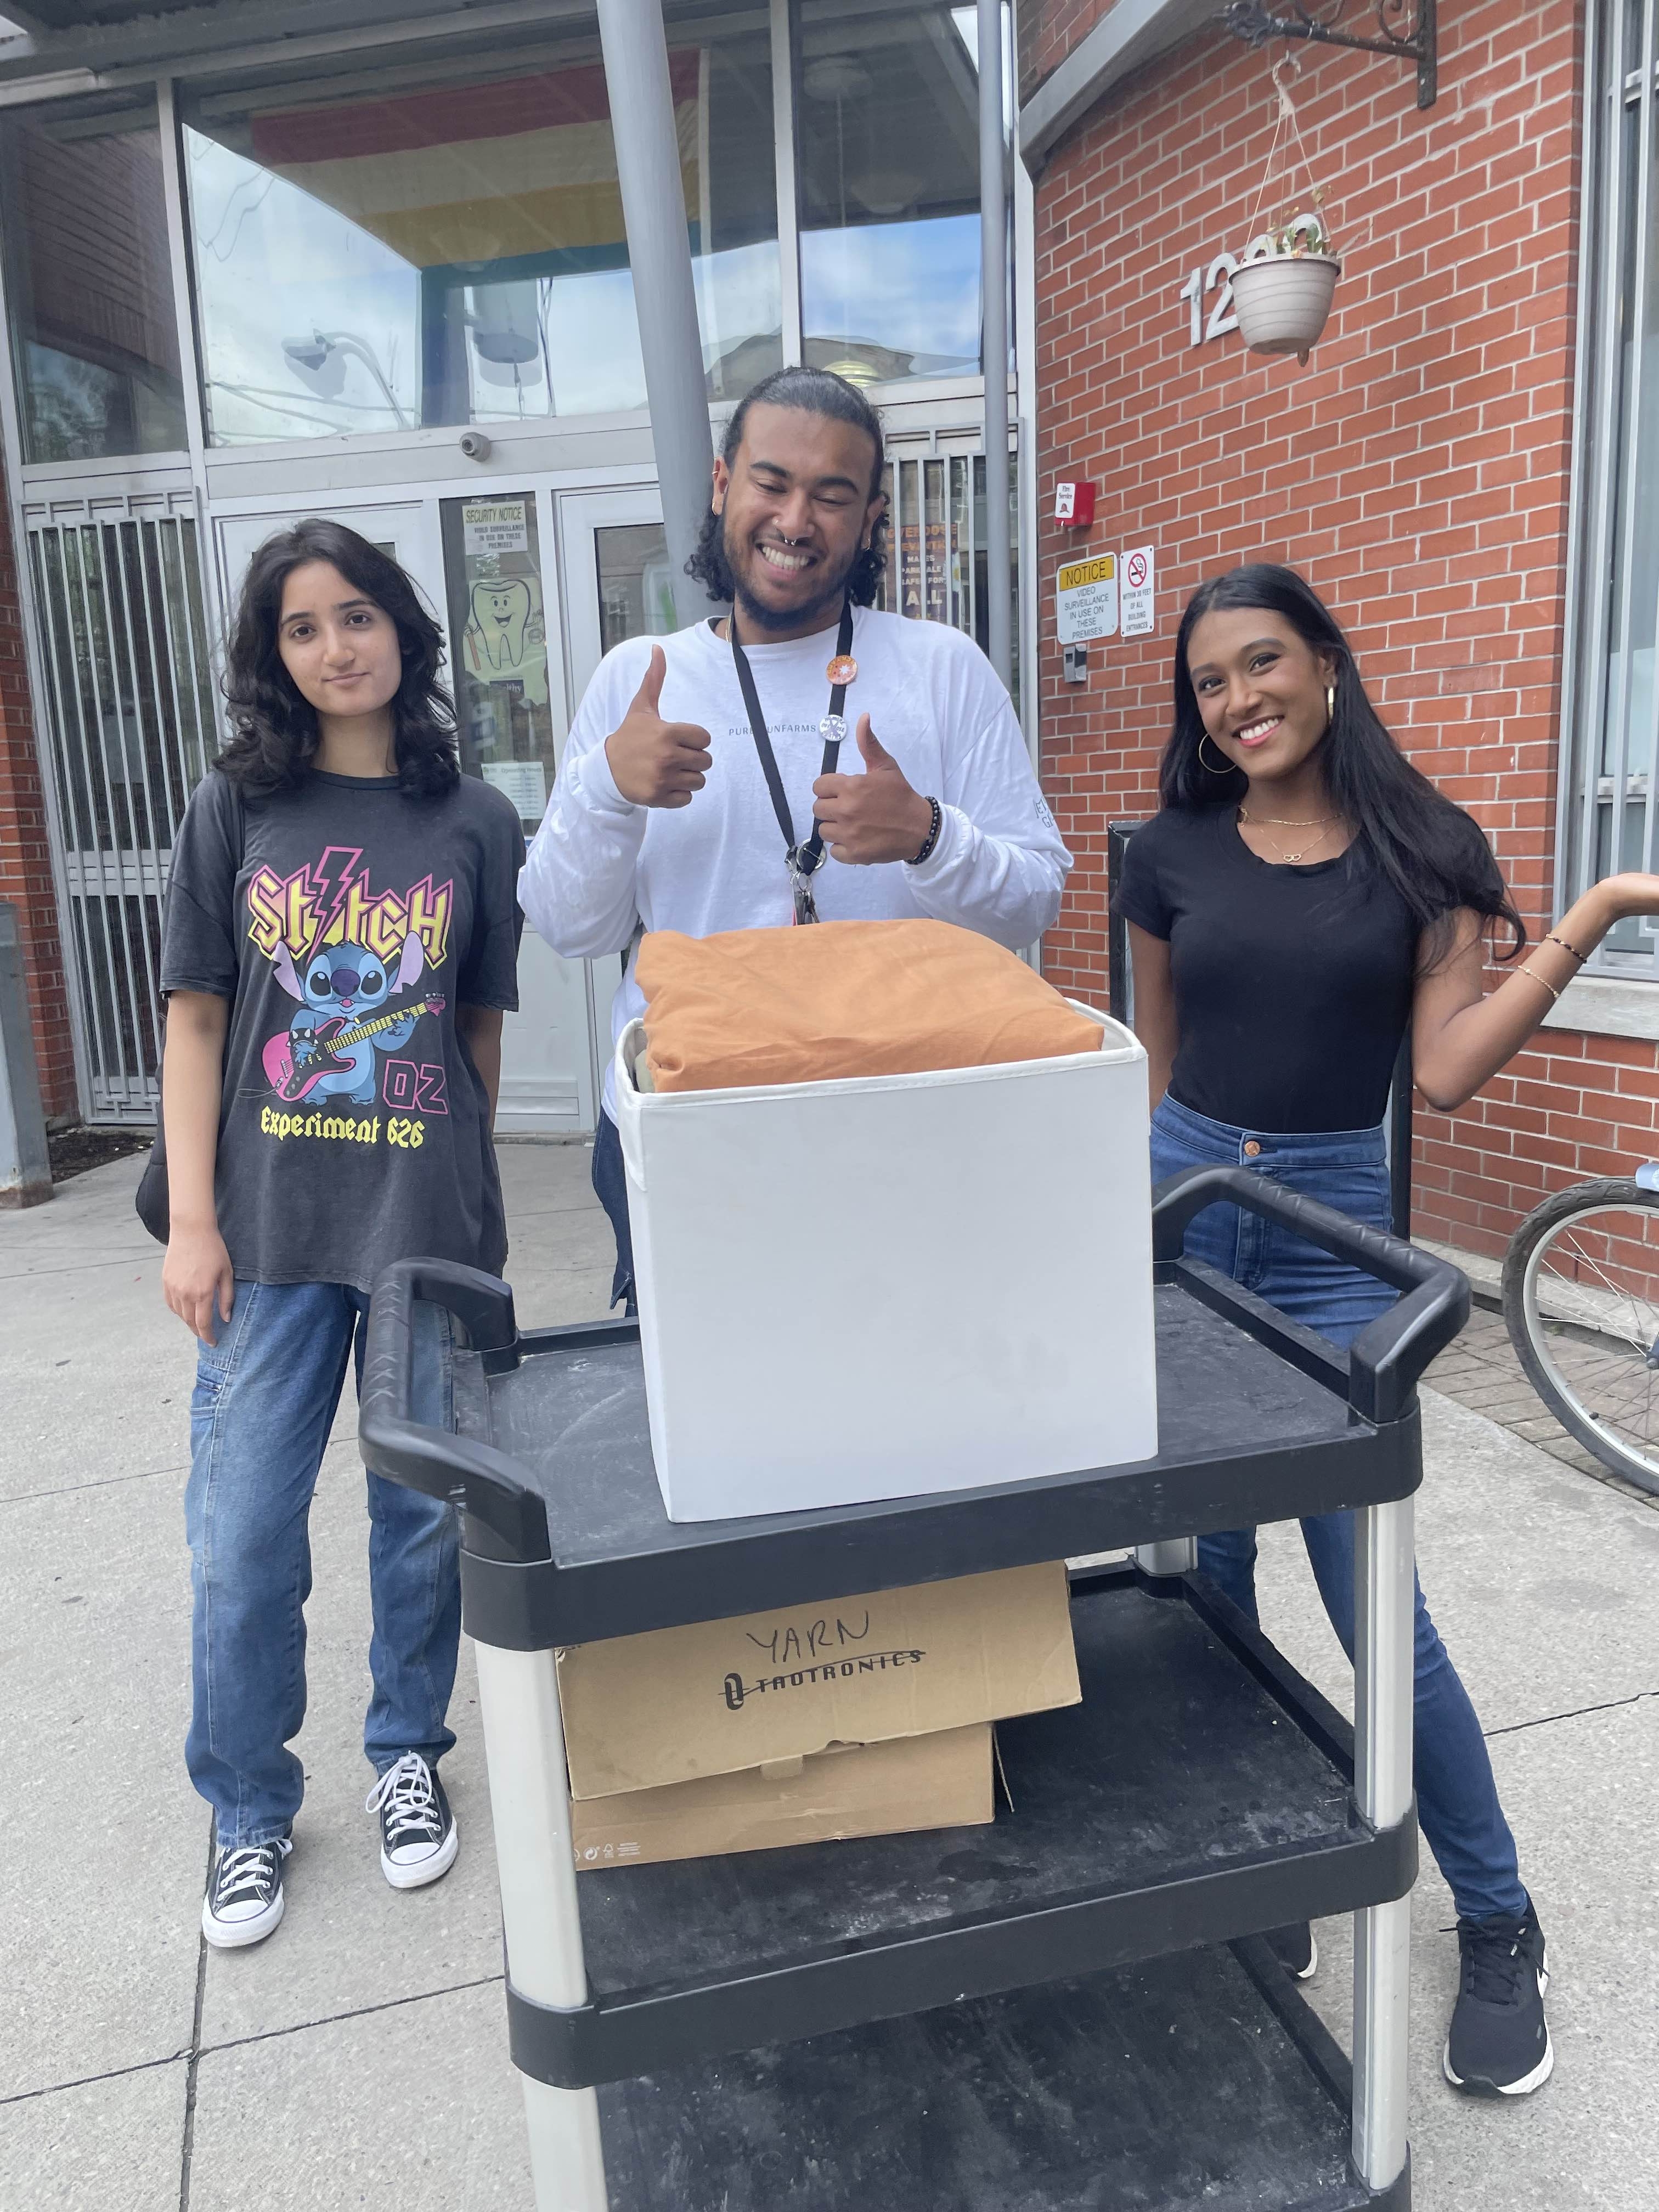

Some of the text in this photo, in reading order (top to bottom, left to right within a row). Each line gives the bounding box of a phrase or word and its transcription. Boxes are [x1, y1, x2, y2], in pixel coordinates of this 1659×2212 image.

[466, 506, 522, 523] SECURITY NOTICE
[907, 555, 935, 563] MAES
[1066, 561, 1106, 586] NOTICE
[1077, 586, 1096, 597] VIDEO
[1064, 593, 1109, 611] SURVEILLANCE
[1070, 605, 1104, 619] IN USE ON
[1128, 611, 1146, 620] BUILDING
[1077, 617, 1097, 628] THESE
[1126, 621, 1148, 632] ENTRANCES
[1072, 627, 1103, 640] PREMISES
[768, 724, 816, 733] UNFARMS
[261, 1105, 426, 1149] Experiment 626
[746, 1610, 869, 1664] YARN
